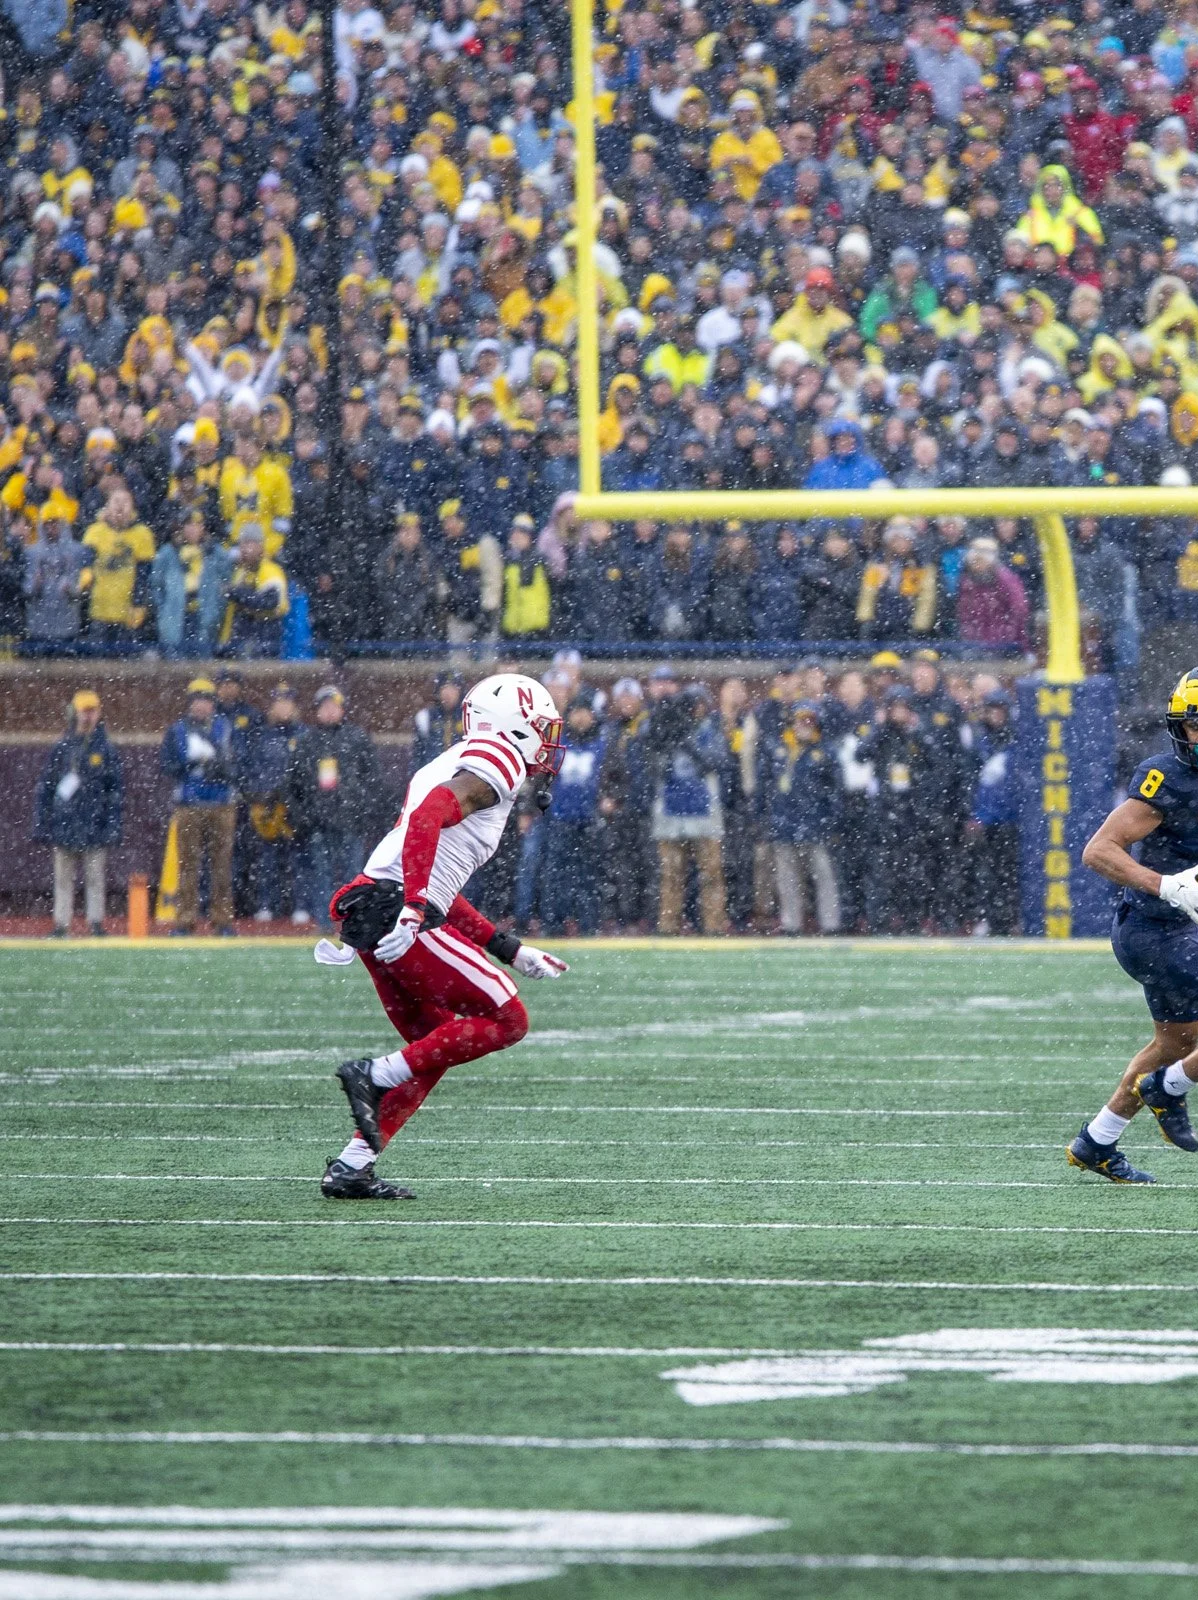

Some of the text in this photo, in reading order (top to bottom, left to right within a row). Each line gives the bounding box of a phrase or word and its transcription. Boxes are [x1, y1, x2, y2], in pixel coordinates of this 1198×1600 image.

[517, 686, 534, 711] N
[1139, 768, 1165, 799] 8
[1037, 687, 1072, 938] MICHIGAN
